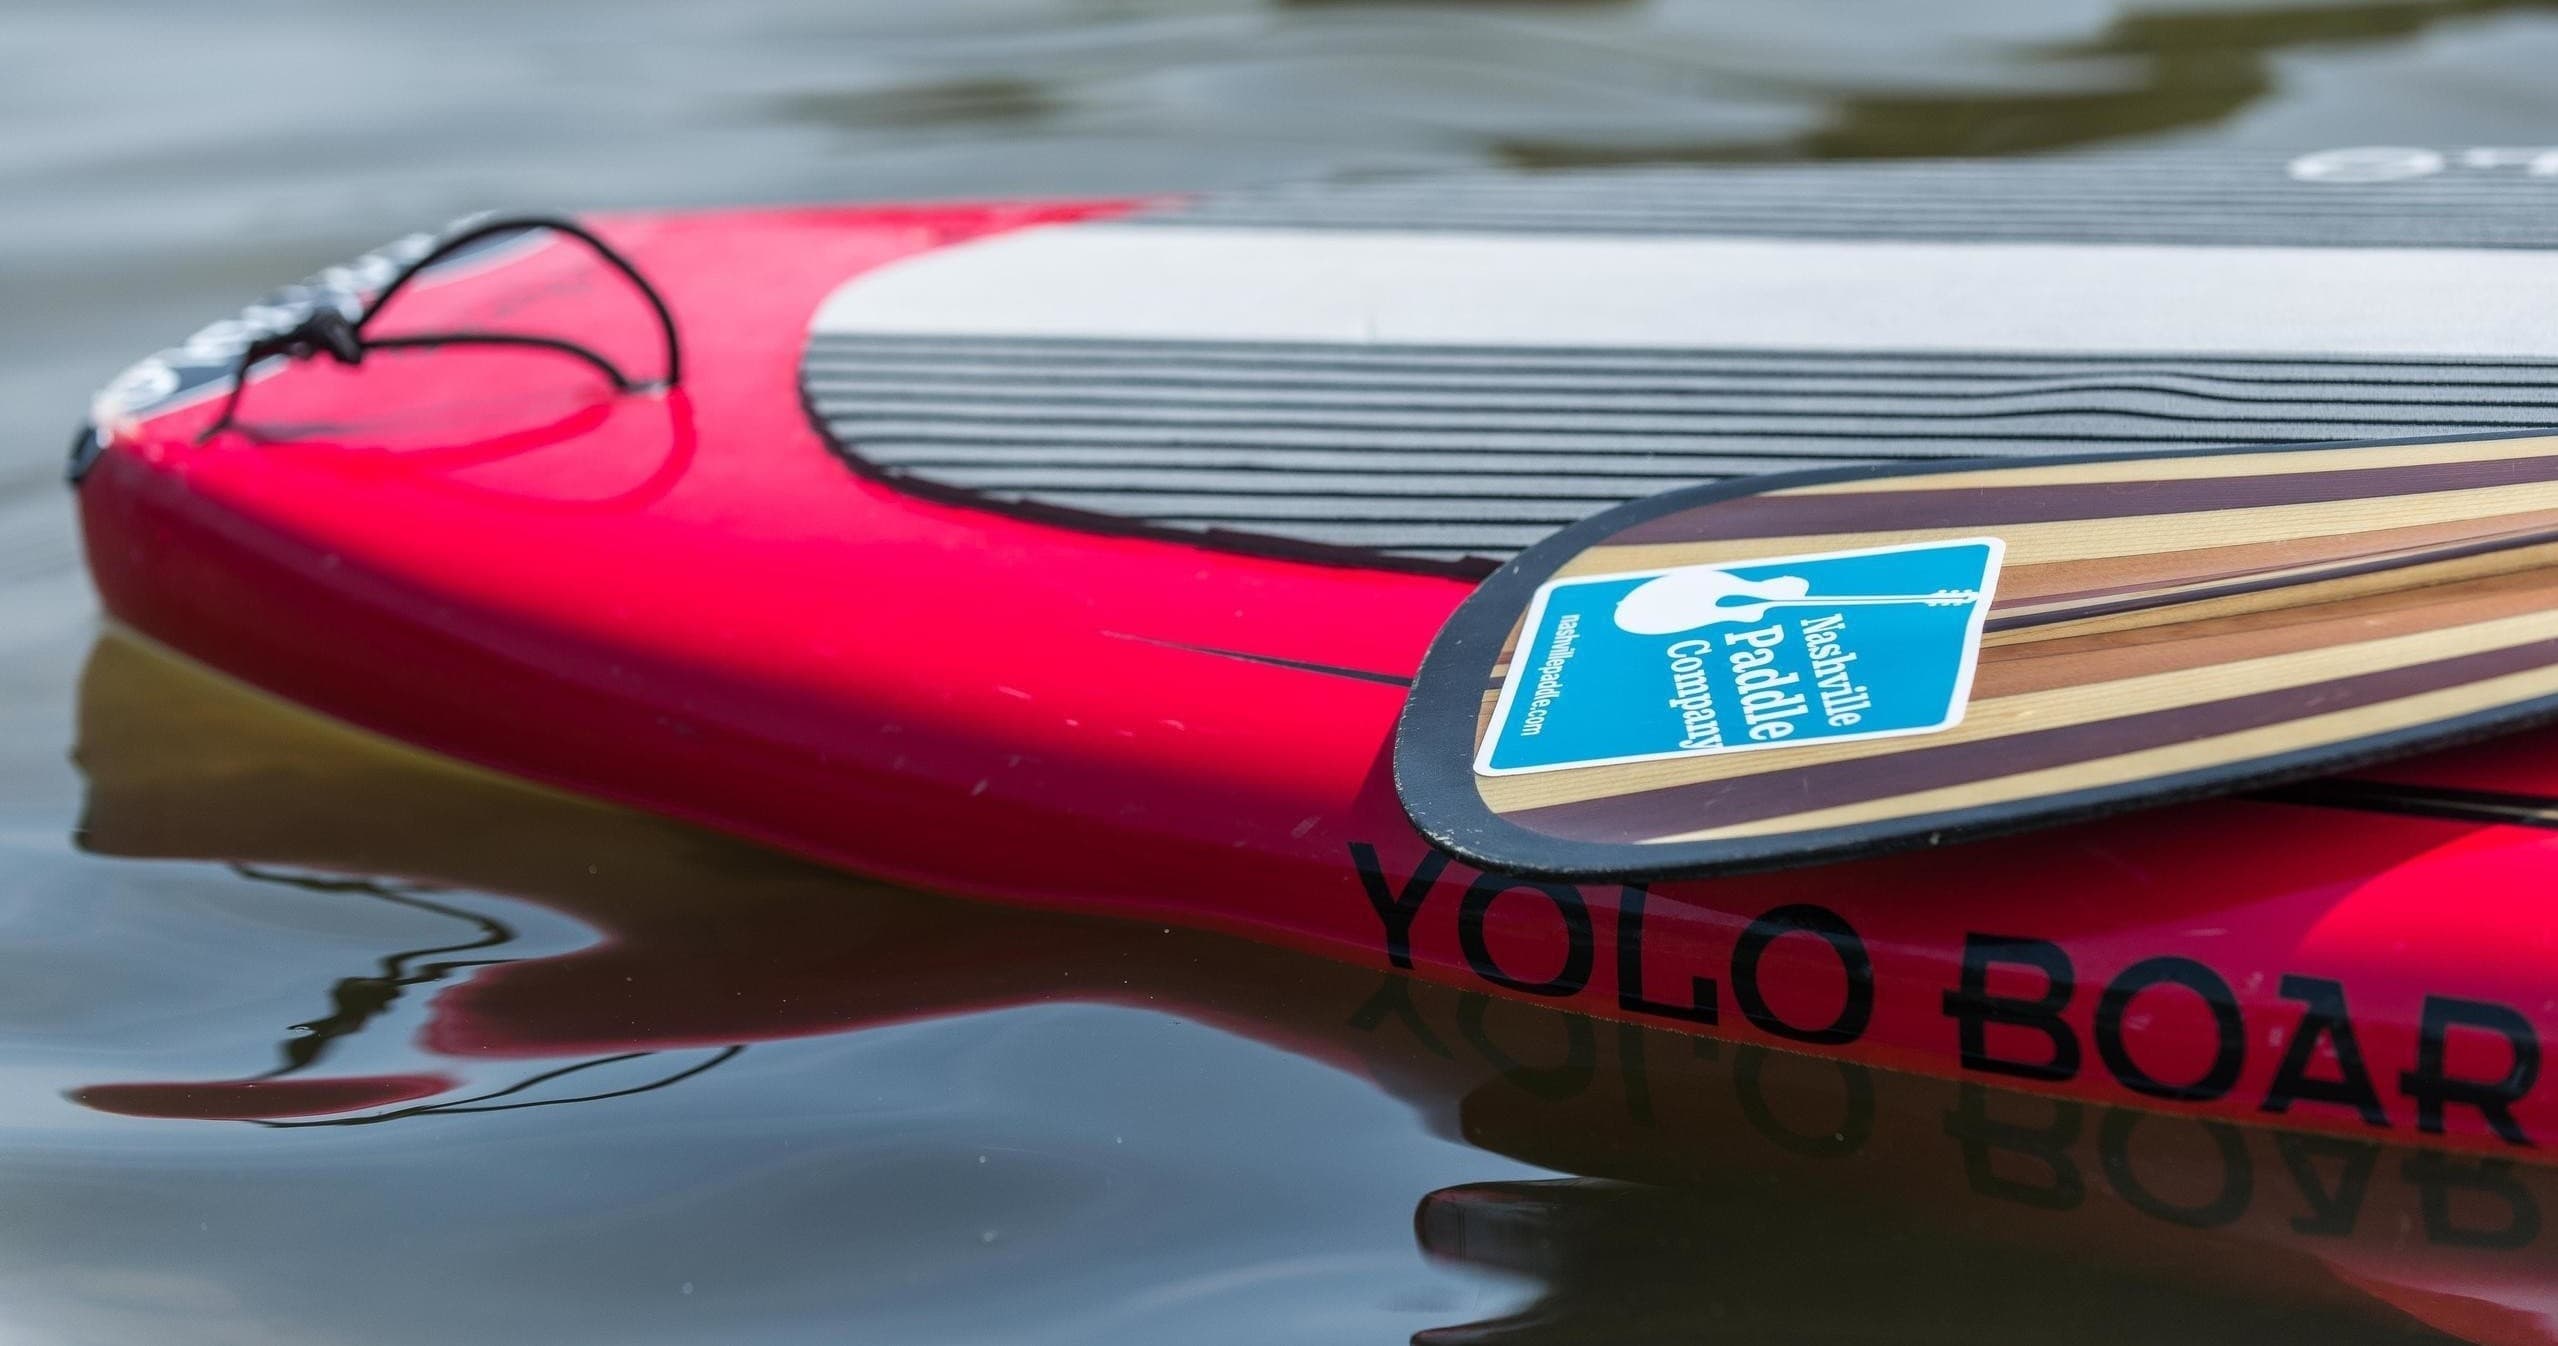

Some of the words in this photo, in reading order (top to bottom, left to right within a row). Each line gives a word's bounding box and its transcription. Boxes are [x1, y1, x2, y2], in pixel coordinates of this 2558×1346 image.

[1520, 613, 1581, 737] nashvillepaddle.com
[1666, 639, 1724, 750] Company
[1724, 624, 1809, 741] Paddle
[1800, 613, 1872, 727] Nashville
[1347, 841, 1875, 1046] YOLO
[1942, 932, 2541, 1148] BOAR
